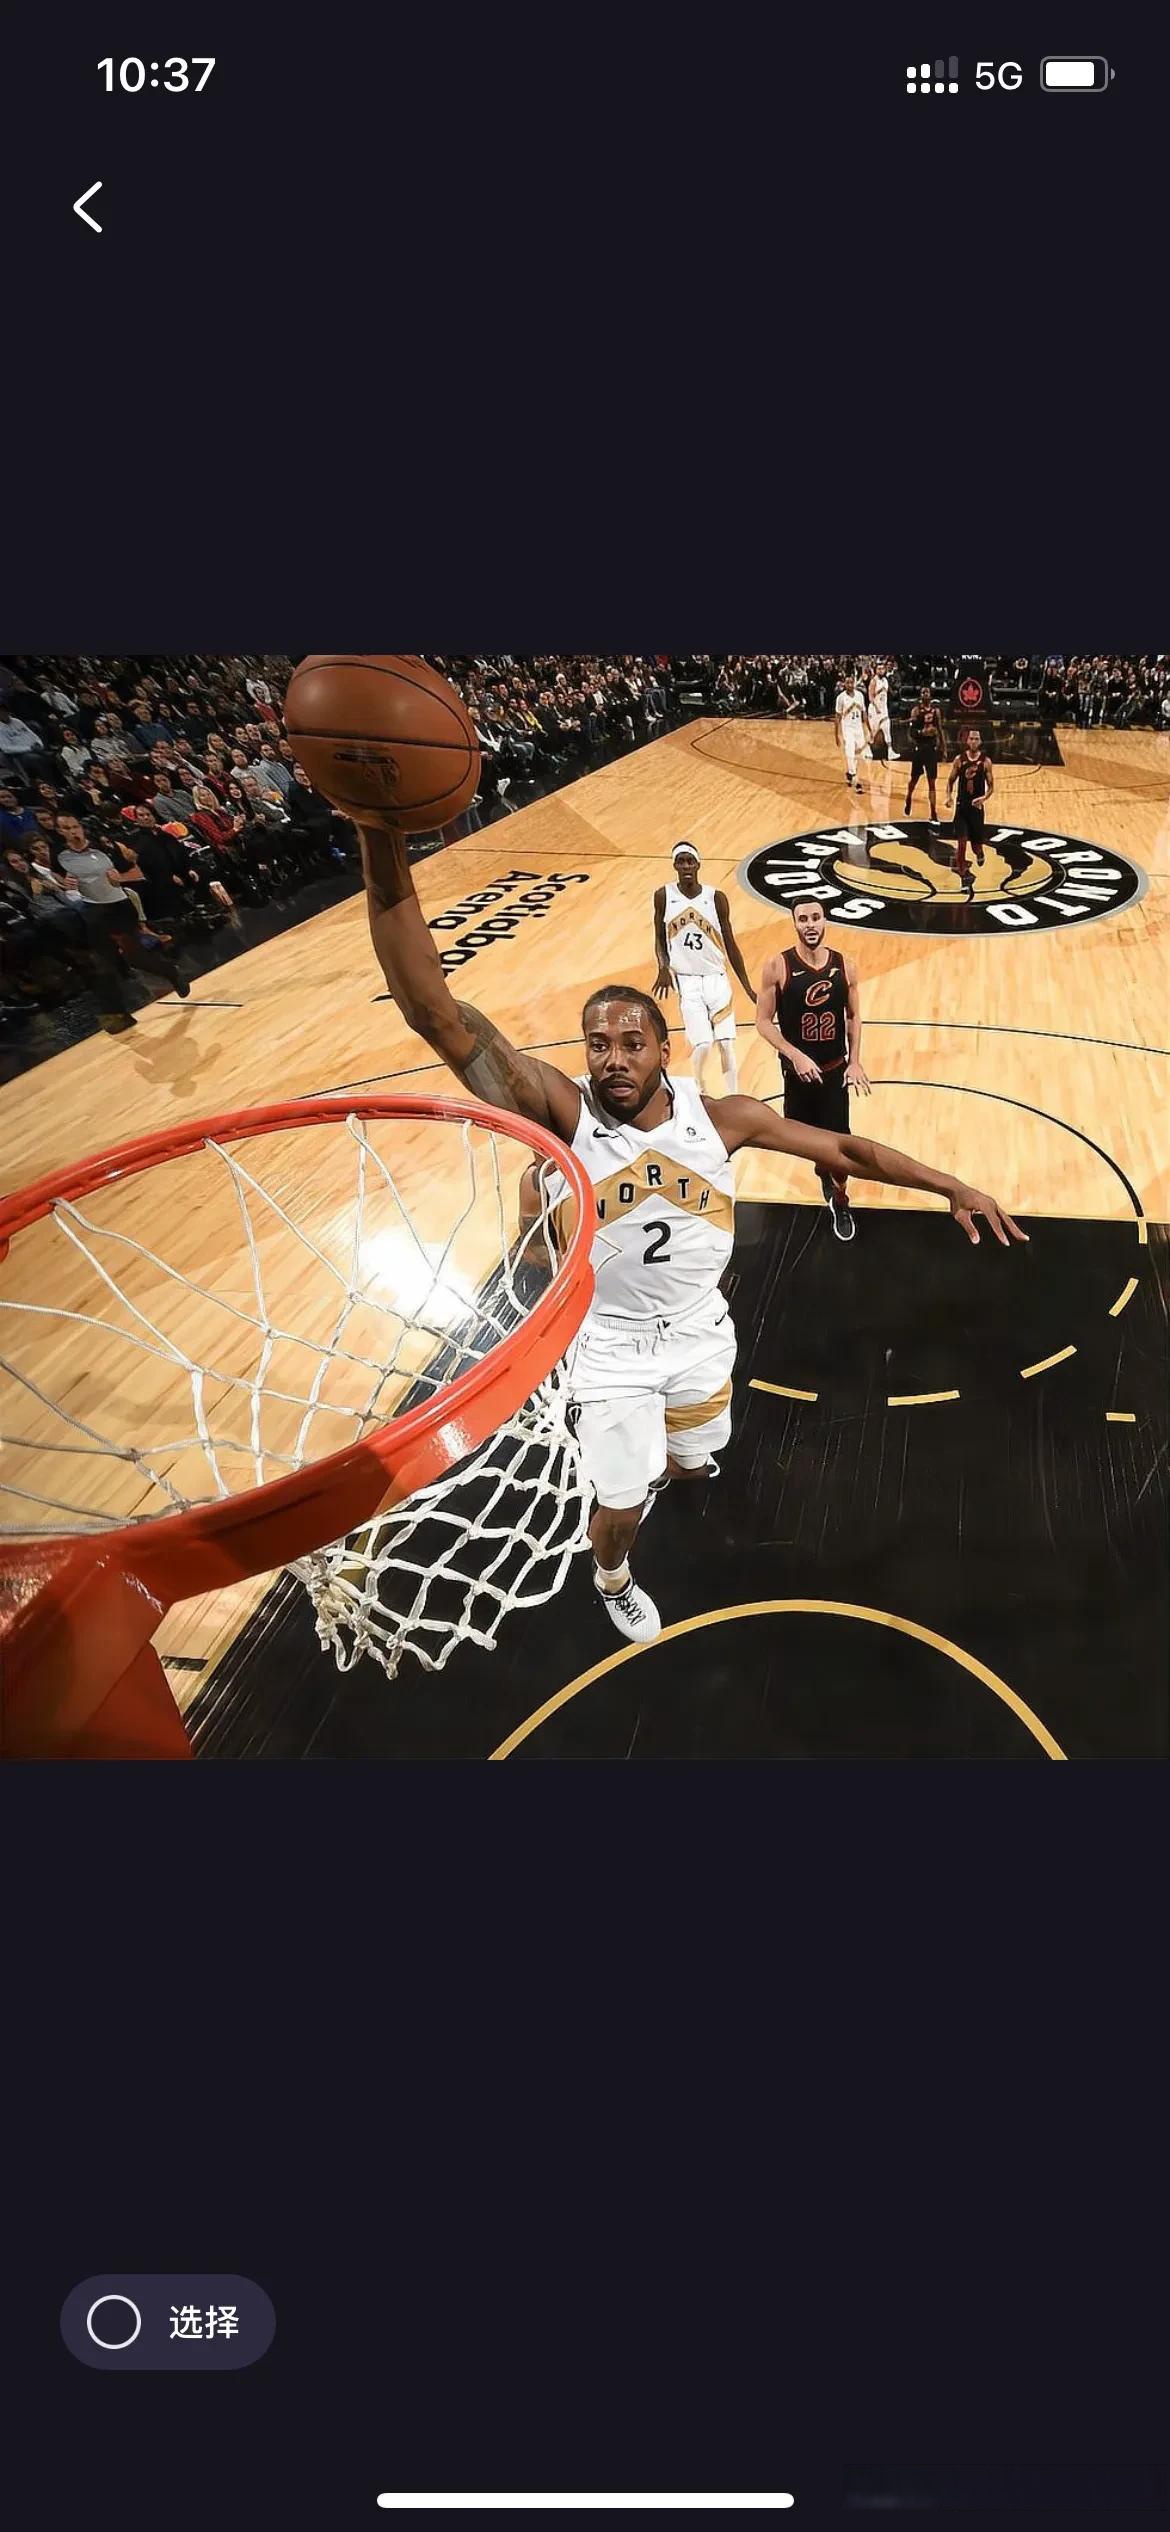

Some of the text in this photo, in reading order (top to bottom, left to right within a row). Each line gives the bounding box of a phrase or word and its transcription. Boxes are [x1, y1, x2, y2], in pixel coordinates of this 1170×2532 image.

[764, 826, 909, 920] RAPTORS
[986, 828, 1123, 926] TORONTO
[428, 870, 543, 930] Arena
[438, 873, 590, 979] Scotiaba
[671, 912, 711, 934] NORTH
[684, 932, 703, 950] 43
[801, 1011, 837, 1041] 22
[641, 1220, 671, 1265] 2
